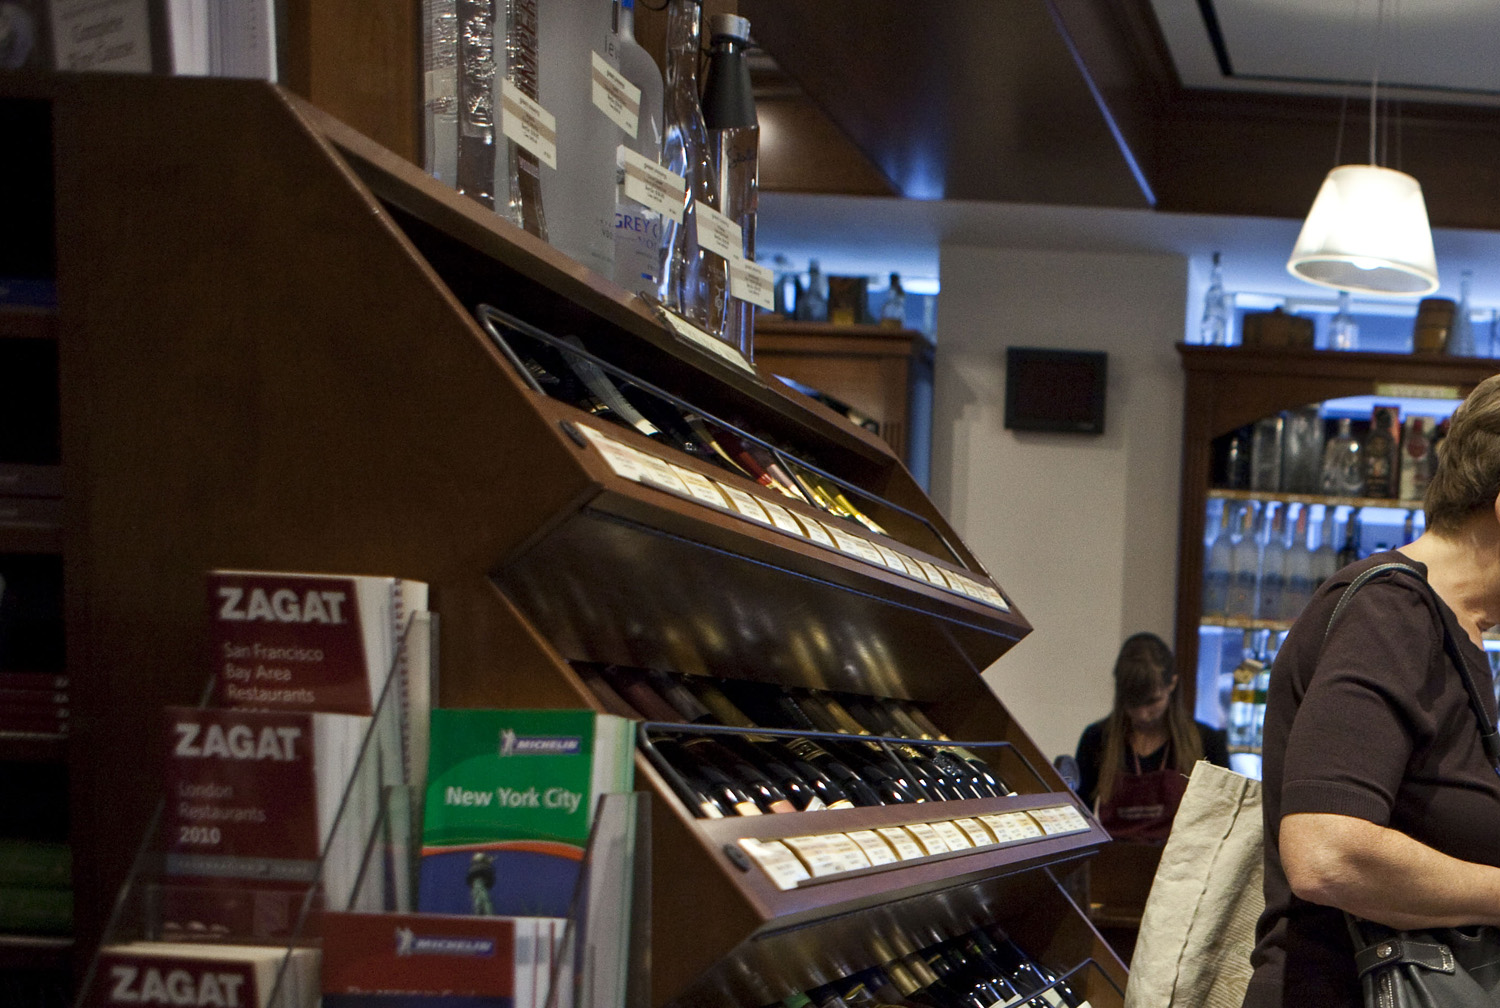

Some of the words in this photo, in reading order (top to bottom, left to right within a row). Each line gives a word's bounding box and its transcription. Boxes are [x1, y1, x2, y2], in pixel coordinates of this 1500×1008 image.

[217, 586, 347, 625] ZAGAT
[223, 641, 251, 660] San
[253, 642, 325, 662] Francisco
[225, 663, 252, 686] Bay
[256, 664, 292, 682] Area
[227, 684, 316, 704] Restaurants
[174, 722, 302, 762] ZAGAT
[517, 739, 580, 750] MICHELIN
[444, 785, 494, 806] New
[495, 786, 542, 809] York
[542, 787, 583, 815] City
[179, 802, 267, 823] Restaurants
[179, 825, 222, 845] 2010
[415, 938, 493, 953] MICHELIN
